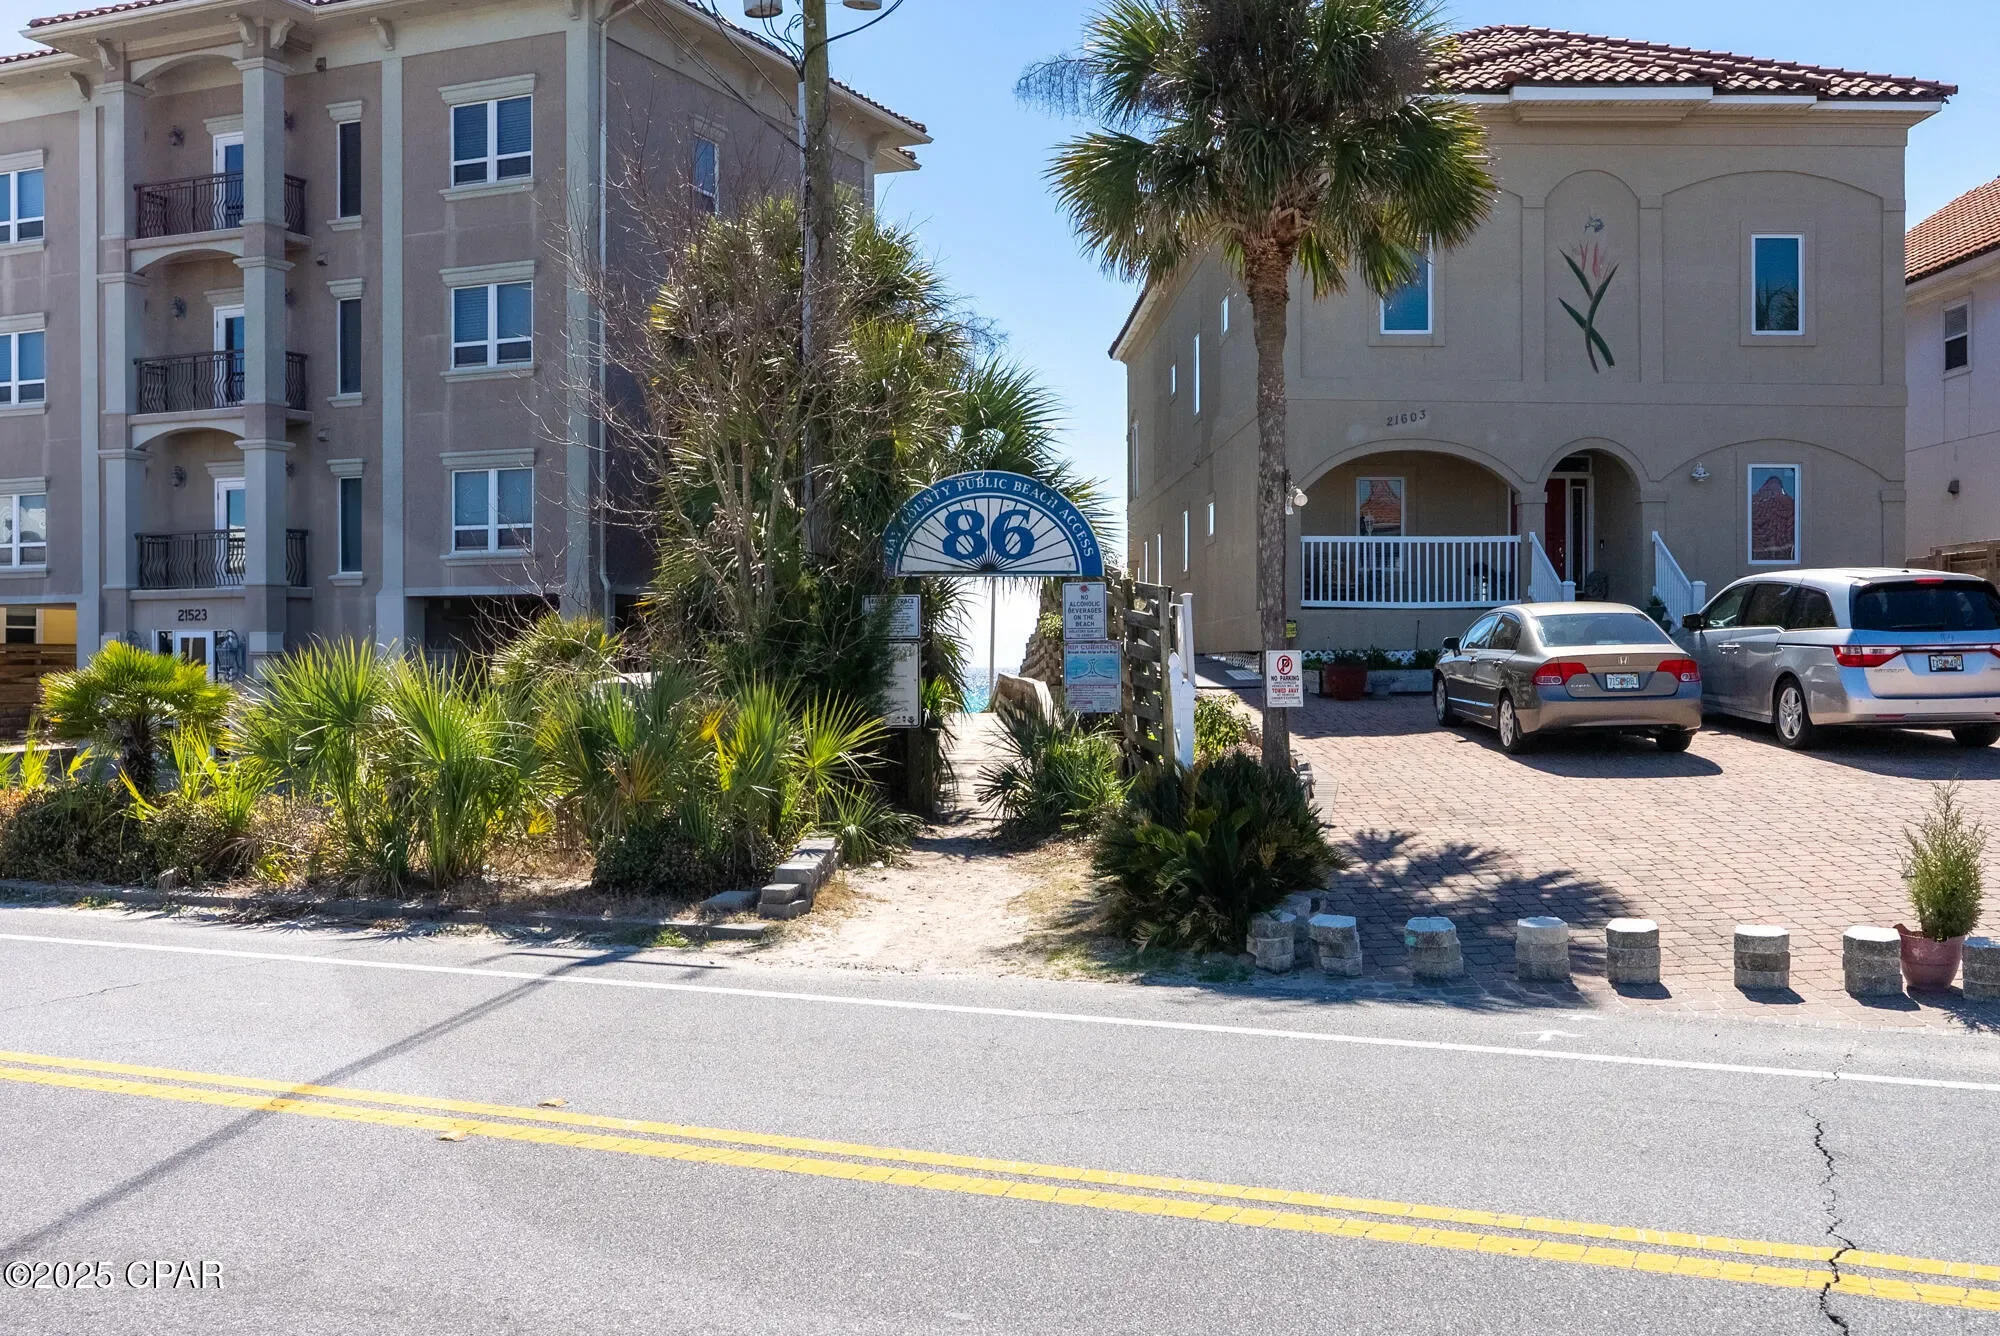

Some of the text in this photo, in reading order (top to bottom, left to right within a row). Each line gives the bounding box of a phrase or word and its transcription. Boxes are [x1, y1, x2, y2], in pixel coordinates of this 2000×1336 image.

[1386, 410, 1426, 426] 21603
[901, 484, 952, 525] COUNTY
[957, 478, 1007, 492] PUBLIC
[1014, 481, 1059, 509] BEACH
[1059, 509, 1094, 557] ACCESS
[942, 509, 1035, 560] 86
[178, 608, 208, 622] 21523
